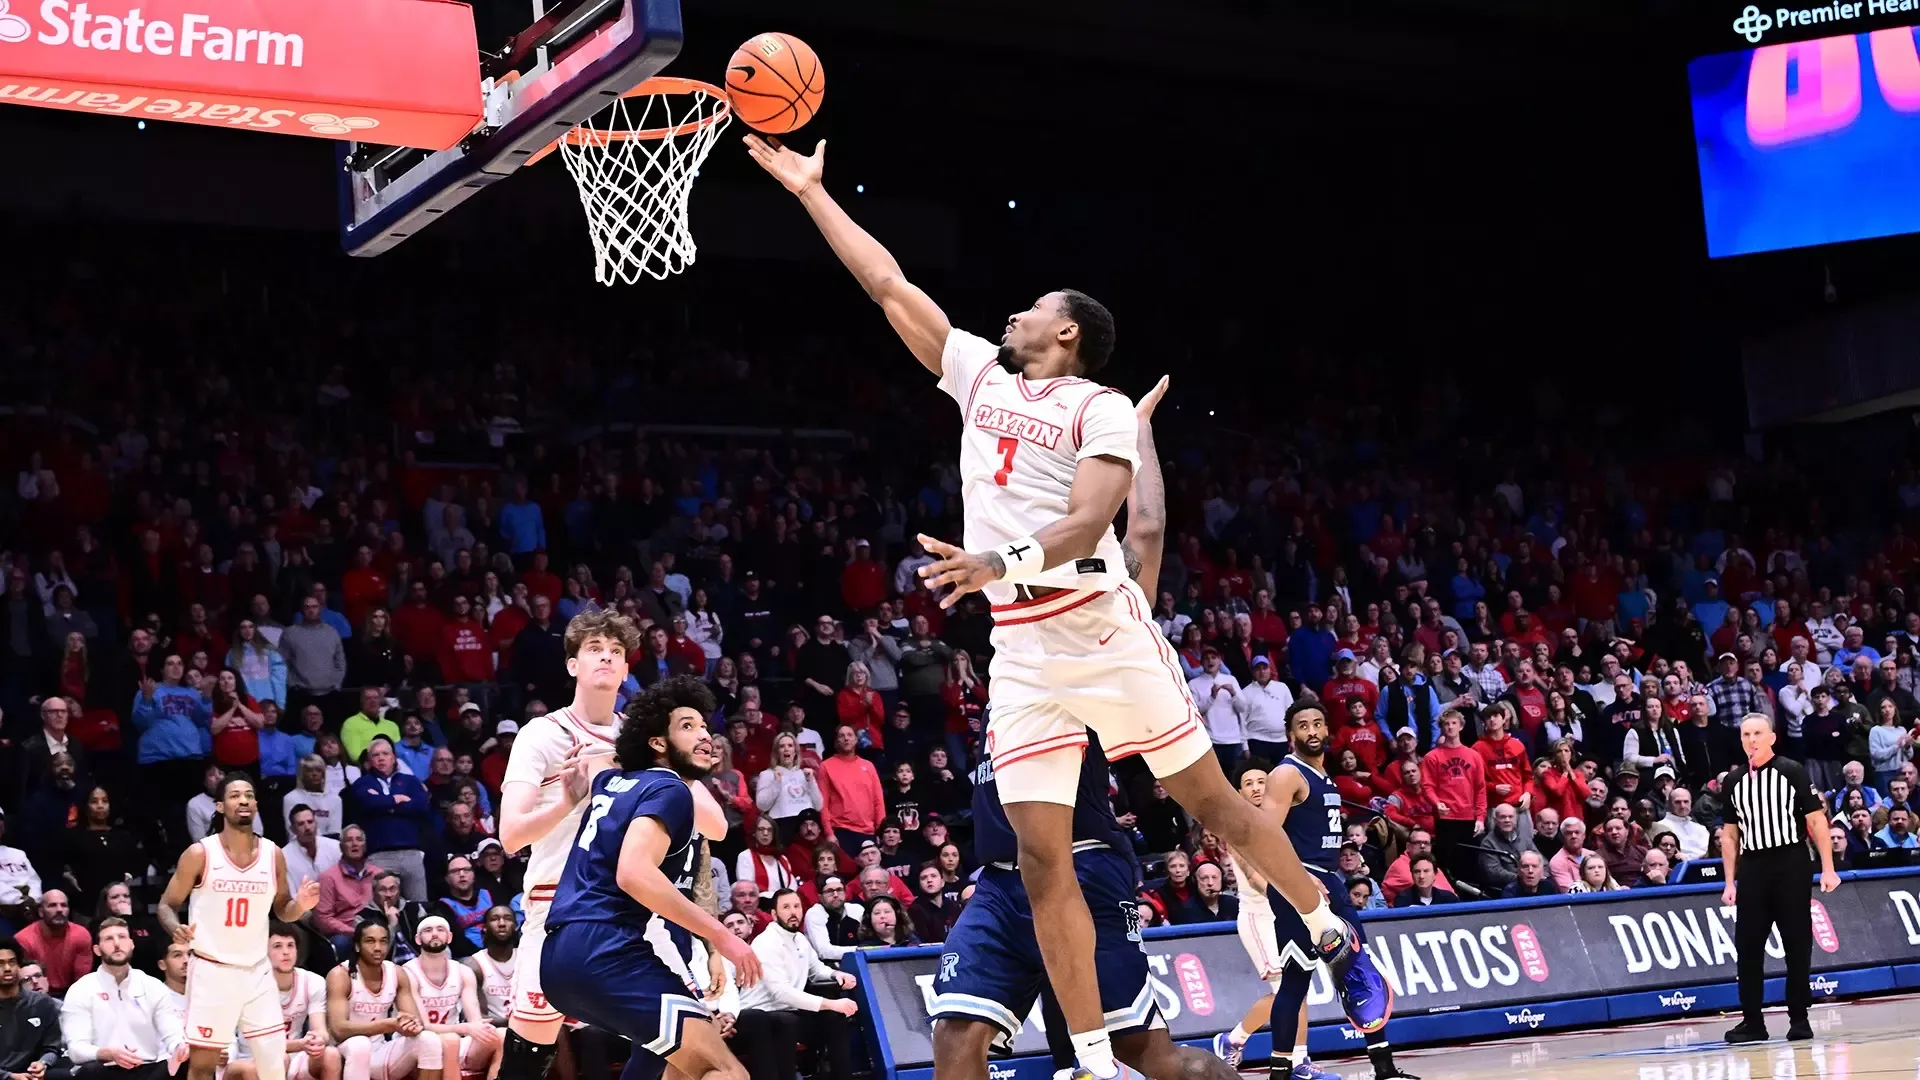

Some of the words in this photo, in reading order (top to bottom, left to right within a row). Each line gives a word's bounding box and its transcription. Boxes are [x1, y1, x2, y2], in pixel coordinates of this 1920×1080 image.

[1776, 1, 1862, 28] Premier
[976, 404, 1063, 450] DAYTON
[994, 437, 1019, 486] 7
[213, 879, 269, 894] DAYTON
[224, 898, 249, 928] 10
[1516, 930, 1545, 977] PIZZA
[1181, 959, 1210, 1010] PIZZA
[1671, 991, 1696, 1010] Kroger
[1518, 1008, 1545, 1028] Kroger
